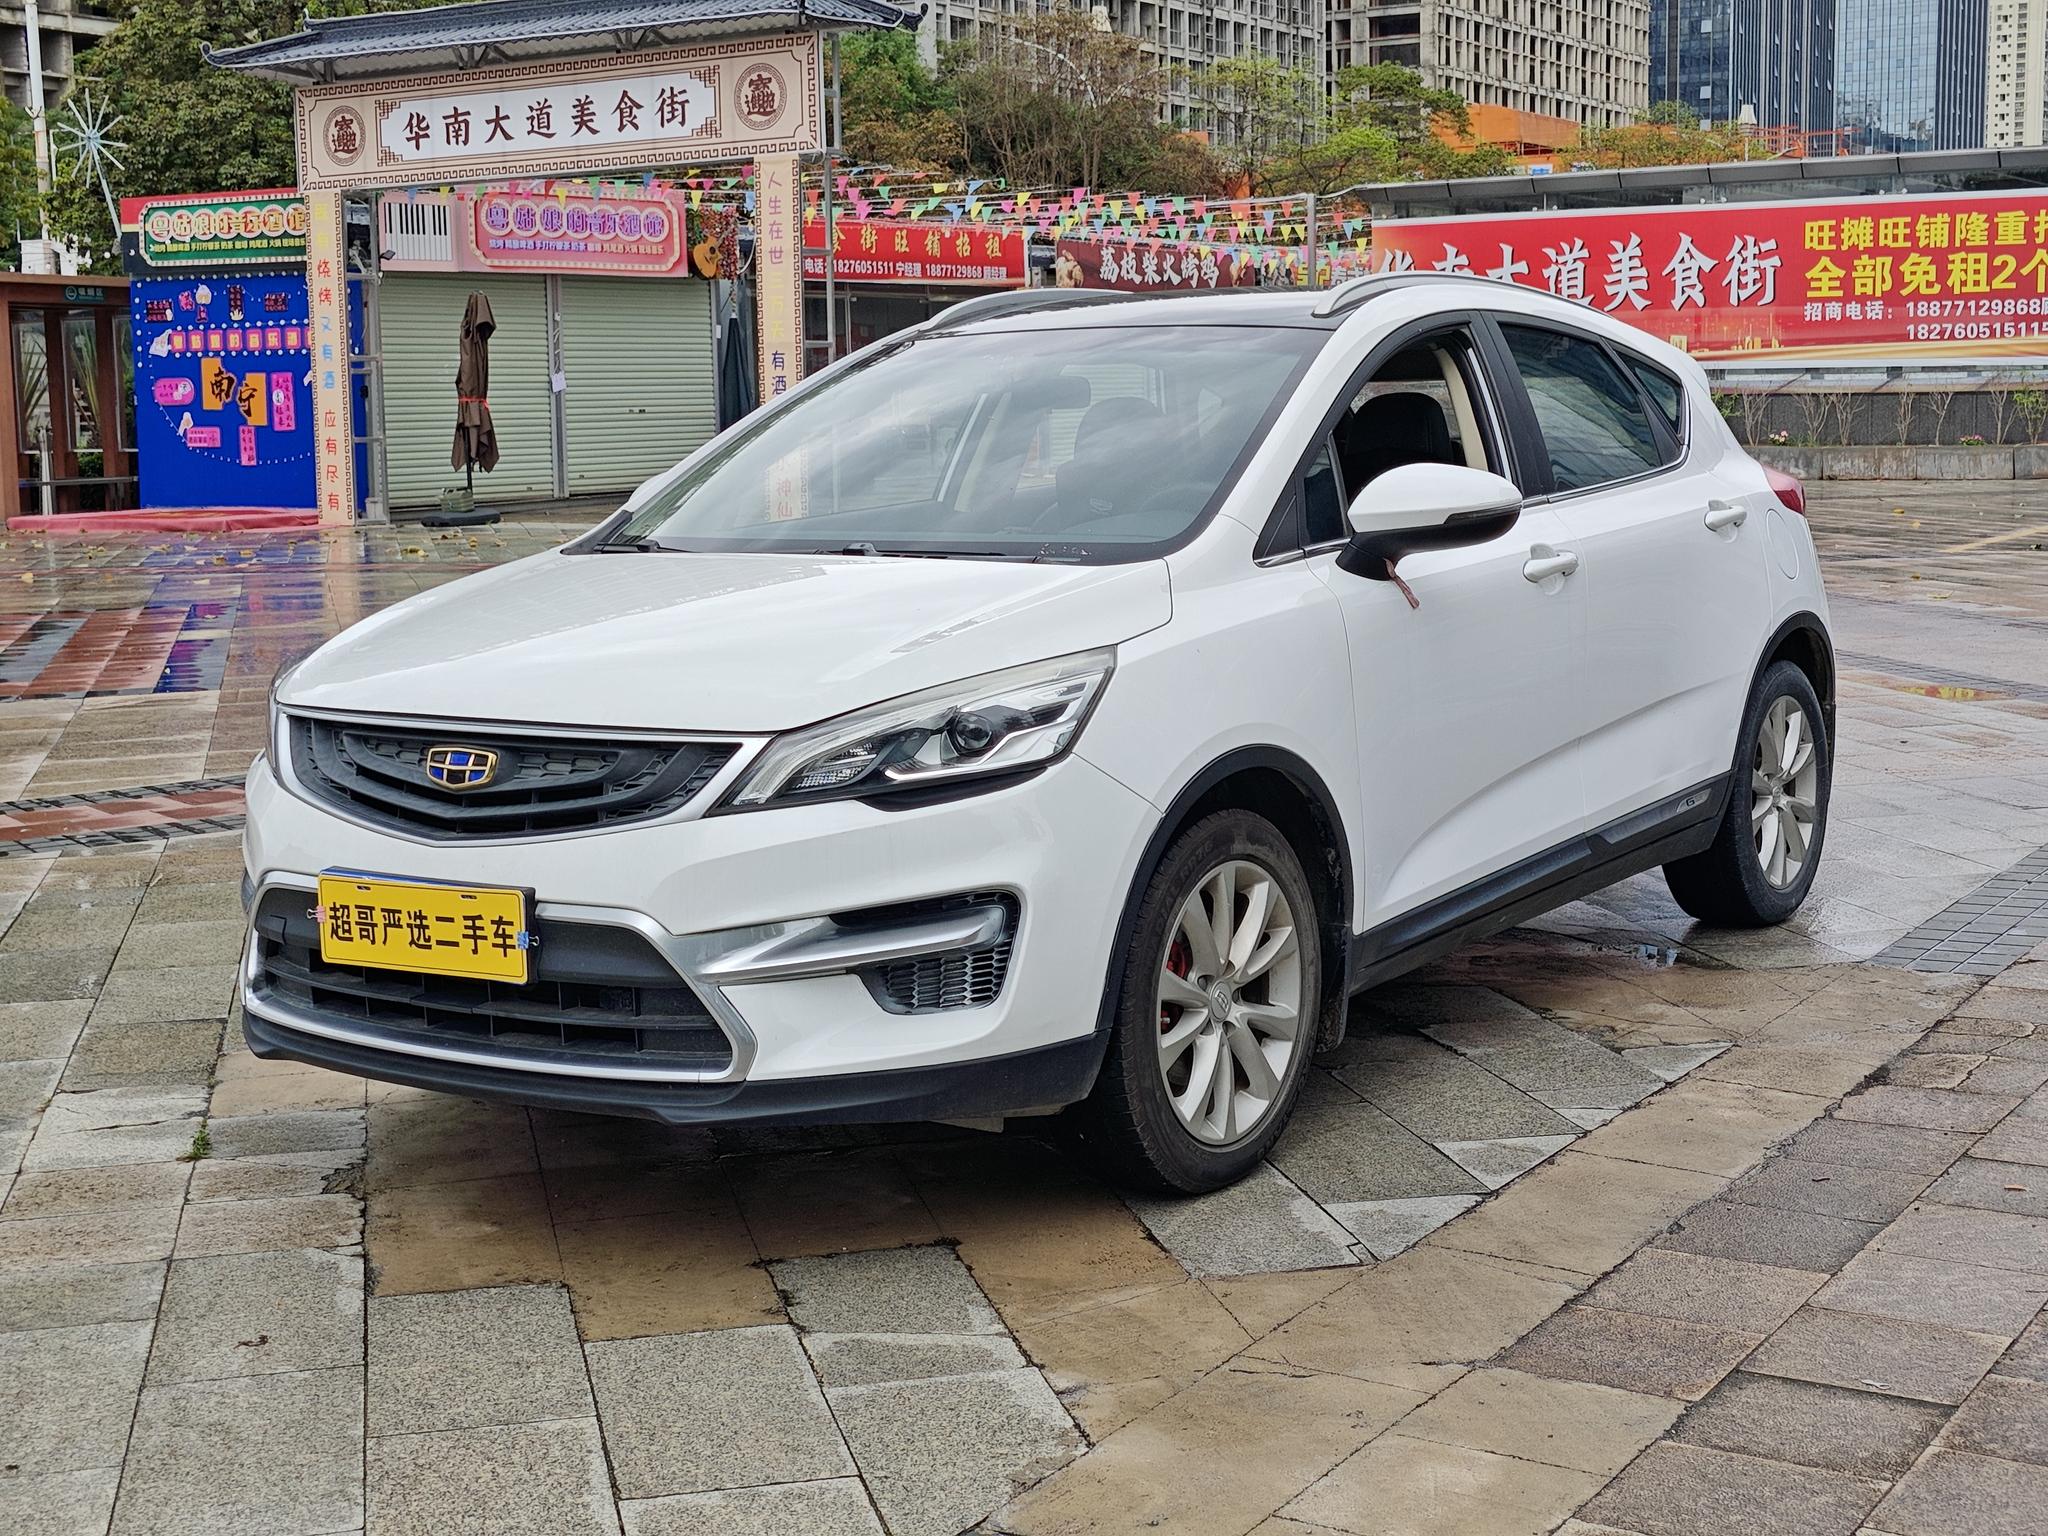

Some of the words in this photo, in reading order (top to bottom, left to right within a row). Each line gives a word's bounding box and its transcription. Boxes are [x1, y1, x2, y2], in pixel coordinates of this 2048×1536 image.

[402, 87, 691, 151] 华南大道美食街
[1099, 246, 1219, 289] 荔枝柴火烤鸡
[1804, 249, 2048, 298] 全部免租2个
[210, 367, 258, 417] 南宁
[329, 902, 516, 957] 超哥严选二手车
